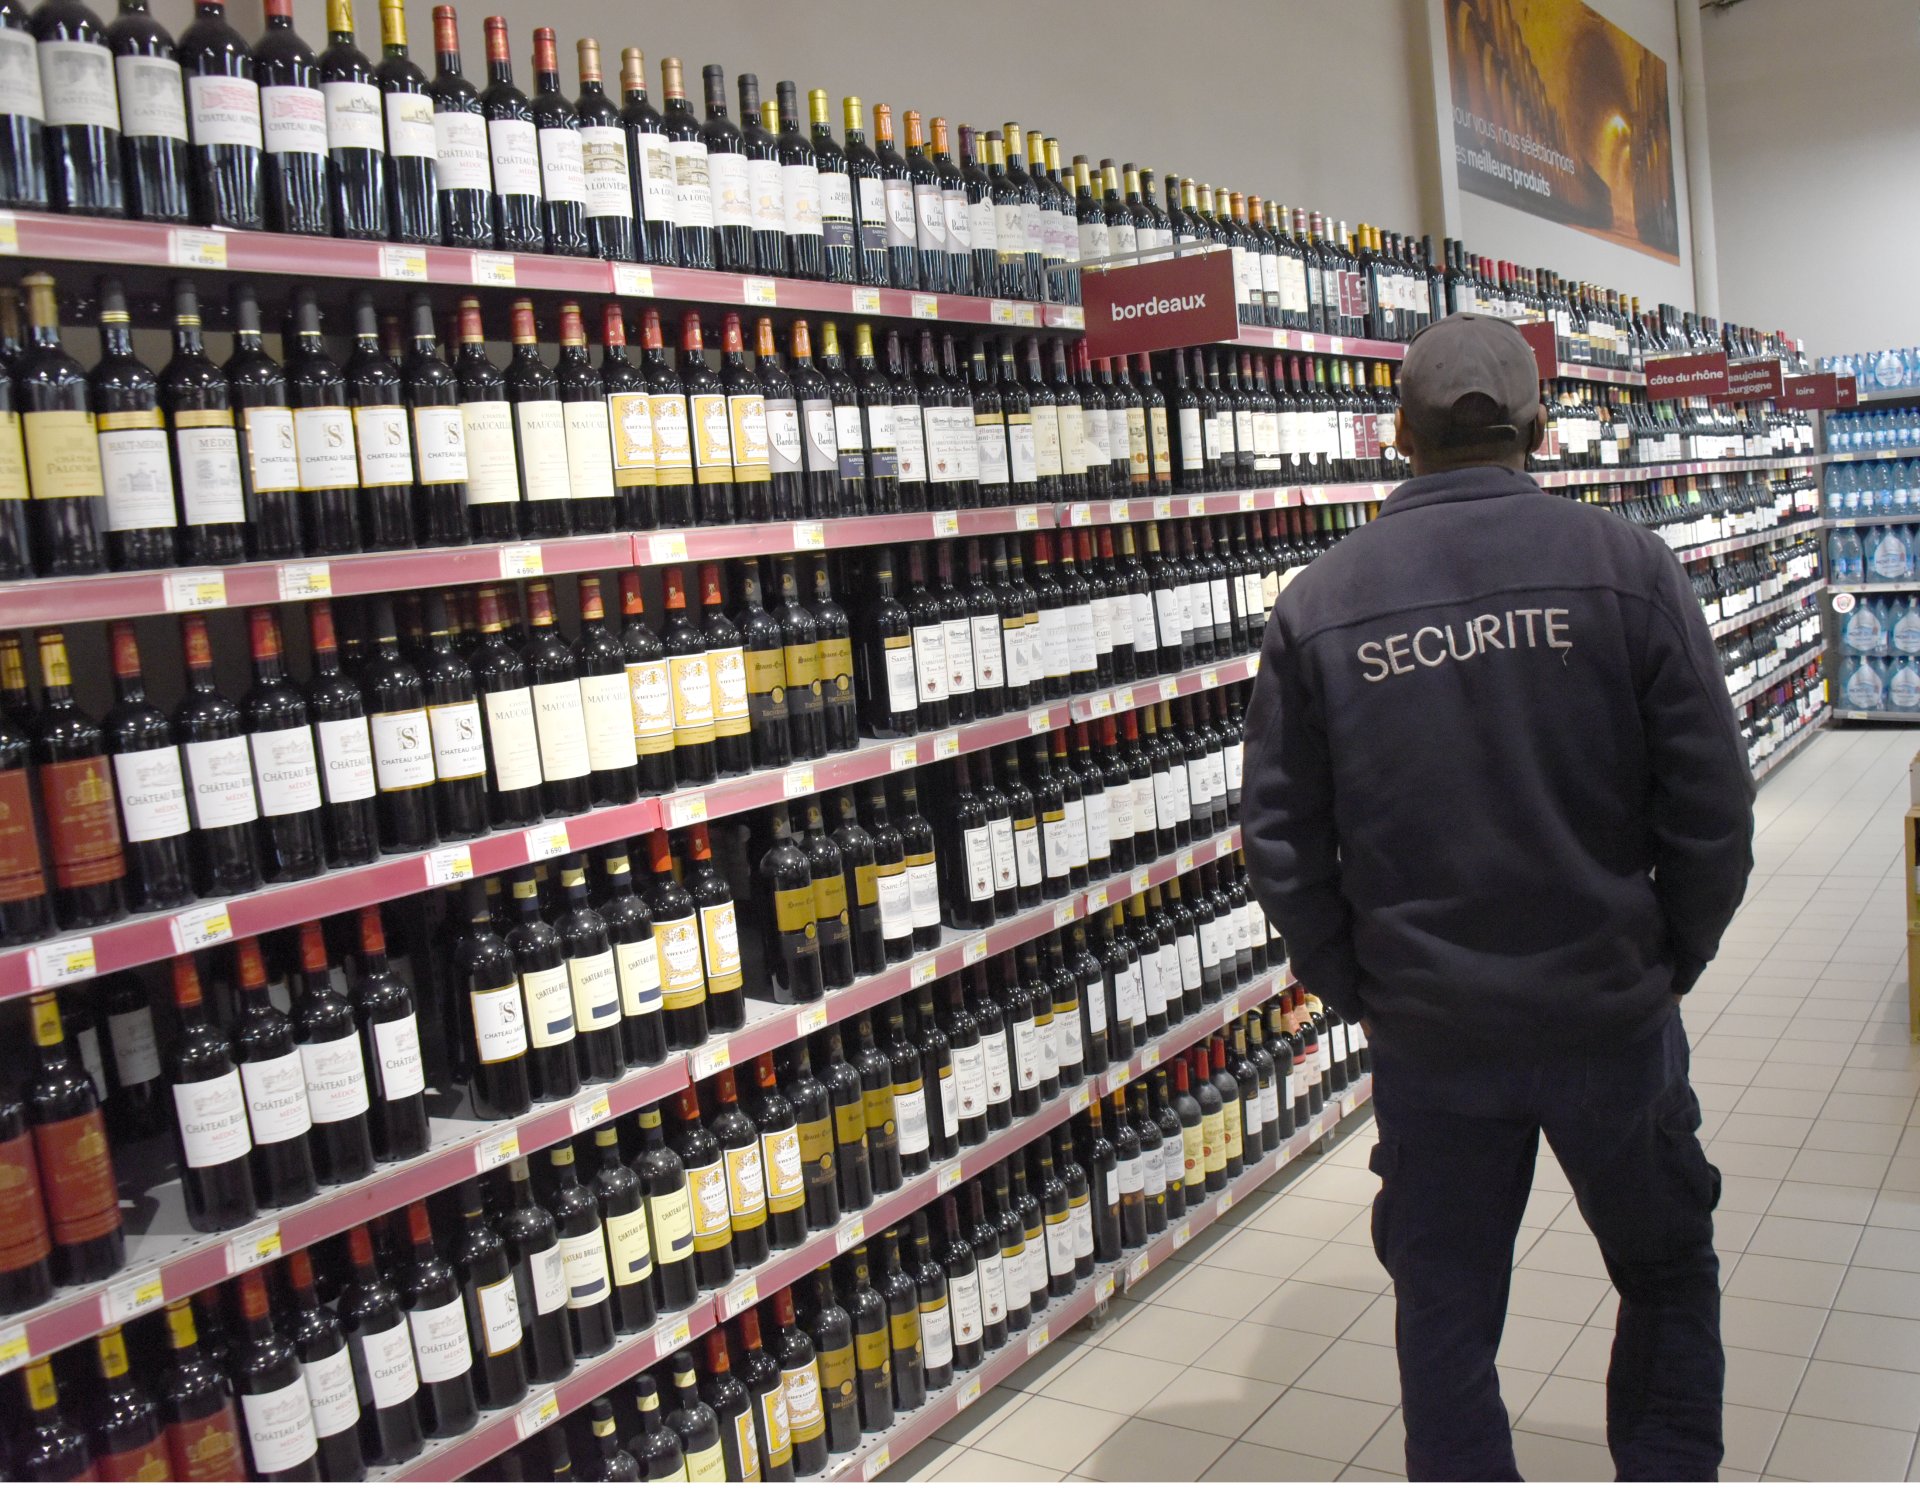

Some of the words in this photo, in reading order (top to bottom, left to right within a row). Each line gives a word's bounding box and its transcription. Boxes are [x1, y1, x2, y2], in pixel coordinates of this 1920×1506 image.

[1467, 145, 1513, 183] meilleurs
[1513, 166, 1551, 197] produits
[1111, 290, 1206, 322] bordeaux
[1650, 373, 1675, 386] côte
[1676, 371, 1690, 383] du
[1691, 369, 1724, 383] rhône
[1795, 386, 1815, 396] loire
[327, 424, 343, 448] S
[387, 422, 401, 445] S
[447, 422, 460, 445] S
[305, 454, 338, 463] CHATEAU
[366, 452, 397, 461] CHATEAU
[427, 451, 457, 459] CHATEAU
[1357, 607, 1573, 682] SECURITE
[459, 718, 474, 740] S
[400, 727, 417, 750] S
[440, 746, 472, 756] CHATEAU
[329, 757, 366, 770] CHÂTEAU
[381, 756, 413, 766] CHATEAU
[262, 768, 299, 783] CHÂTEAU
[198, 780, 242, 794] CHÂTEAU
[126, 793, 172, 807] CHÂTEAU
[551, 846, 562, 854] 690
[450, 870, 464, 878] 290
[627, 956, 650, 972] CHATEAU
[580, 970, 603, 986] CHATEAU
[535, 985, 558, 1001] CHATEAU
[503, 1000, 517, 1023] S
[484, 1028, 513, 1040] CHATEAU
[307, 1079, 346, 1093] CHÂTEAU
[253, 1097, 294, 1112] CHÂTEAU
[590, 1112, 603, 1122] 690
[185, 1120, 228, 1135] CHÂTEAU
[496, 1152, 510, 1162] 290
[661, 1208, 680, 1221] CHATEAU
[617, 1226, 638, 1243] CHATEAU
[420, 1338, 457, 1355] CHÂTEAU
[254, 1424, 297, 1443] CHÂTEAU
